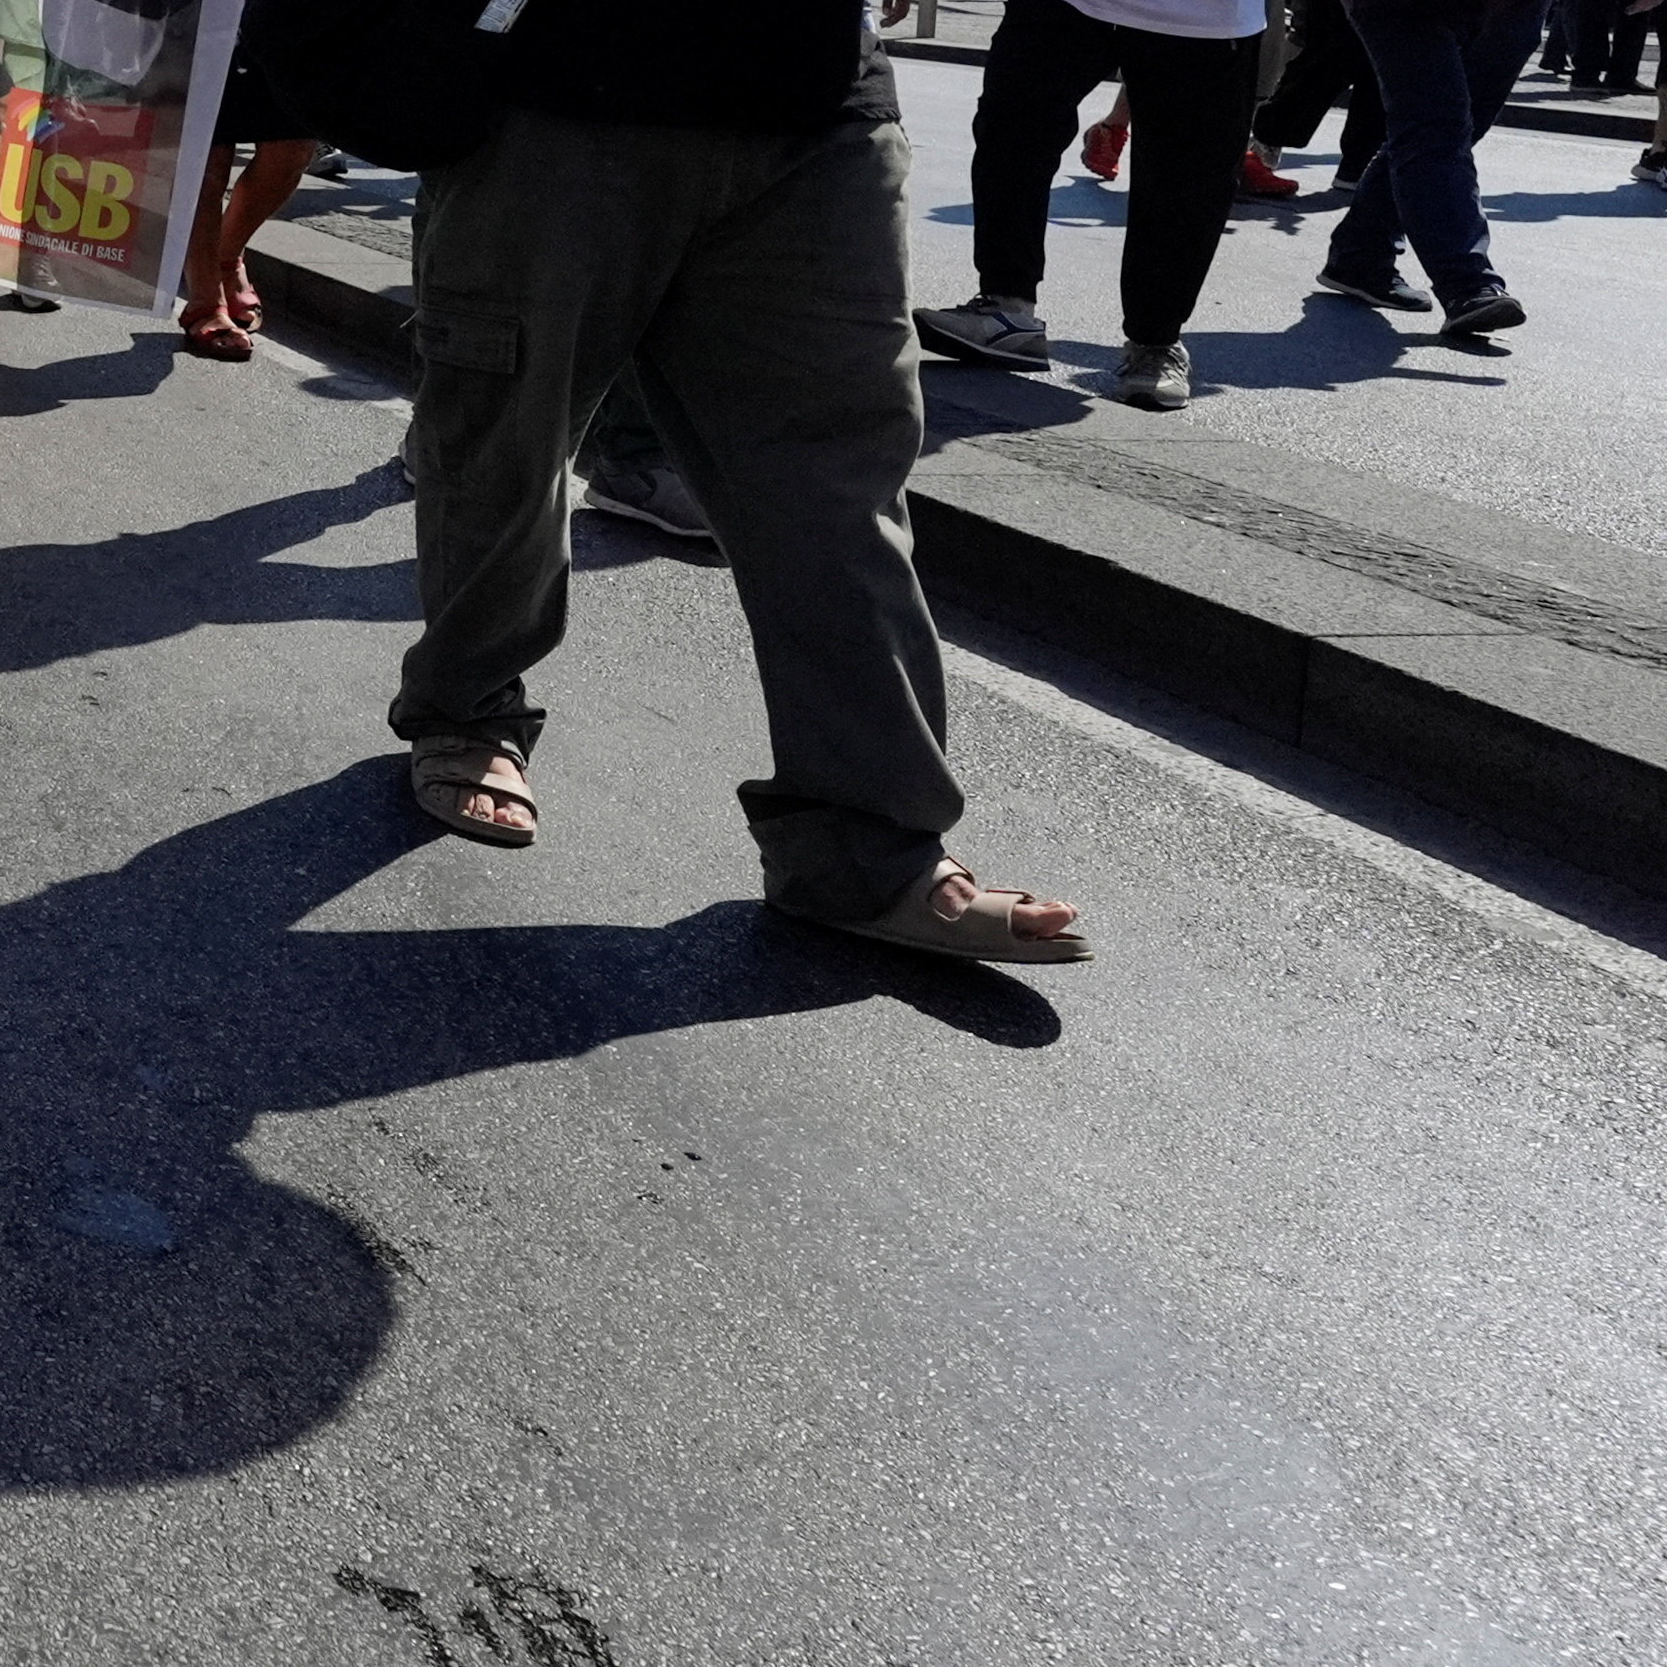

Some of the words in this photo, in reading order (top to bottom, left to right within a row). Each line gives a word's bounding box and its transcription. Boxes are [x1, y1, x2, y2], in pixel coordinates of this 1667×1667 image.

[25, 232, 80, 255] SINDACALE
[81, 239, 95, 257] DI
[96, 245, 125, 263] BASE
